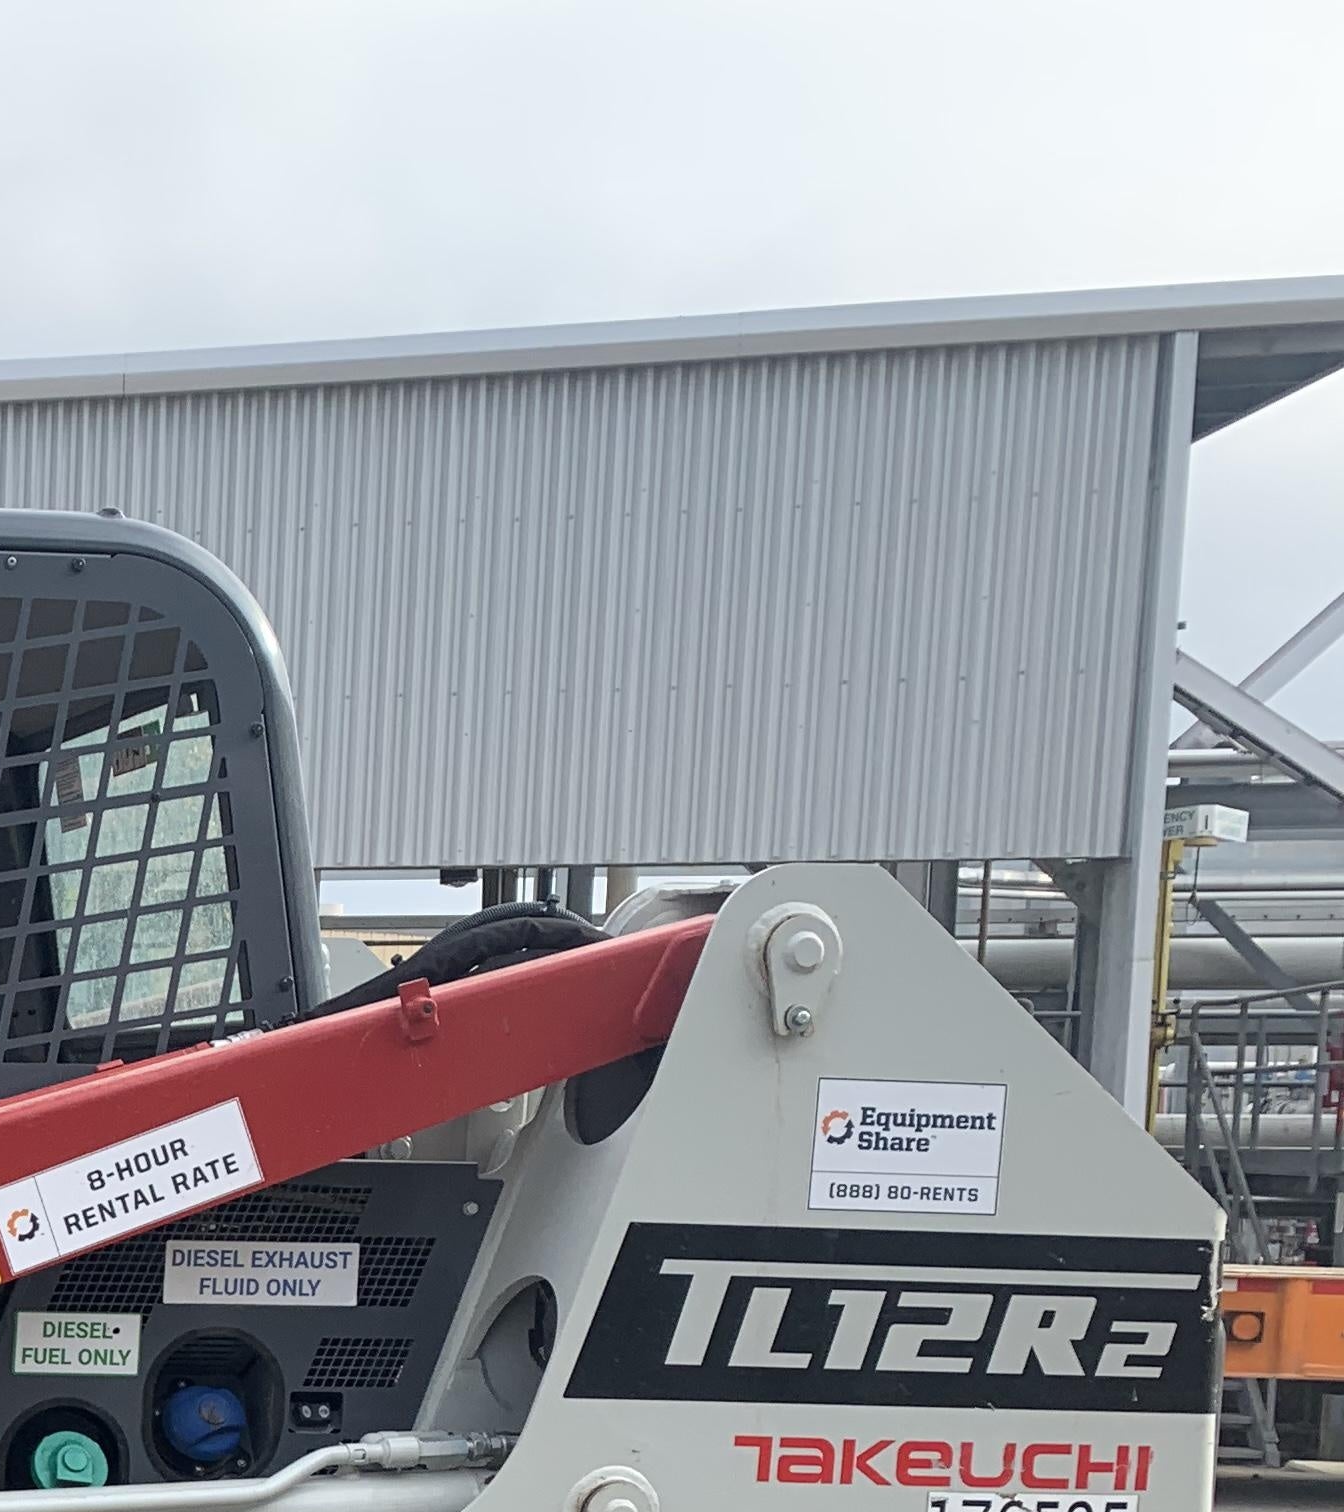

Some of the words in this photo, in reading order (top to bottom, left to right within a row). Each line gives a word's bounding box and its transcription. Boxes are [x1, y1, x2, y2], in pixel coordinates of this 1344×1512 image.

[859, 1107, 996, 1132] Equipment
[857, 1132, 930, 1152] Share
[87, 1138, 189, 1192] 8-HOUR
[64, 1183, 165, 1234] RENTAL
[172, 1152, 240, 1193] RATE
[829, 1182, 880, 1200] (888)
[887, 1185, 979, 1202] 80-RENTS
[171, 1249, 246, 1269] DIESEL
[251, 1251, 352, 1270] EXHAUST
[198, 1277, 260, 1296] FLUID
[265, 1278, 321, 1297] ONLY
[42, 1321, 112, 1340] DIESEL
[21, 1347, 73, 1367] FUEL
[79, 1347, 131, 1367] ONLY
